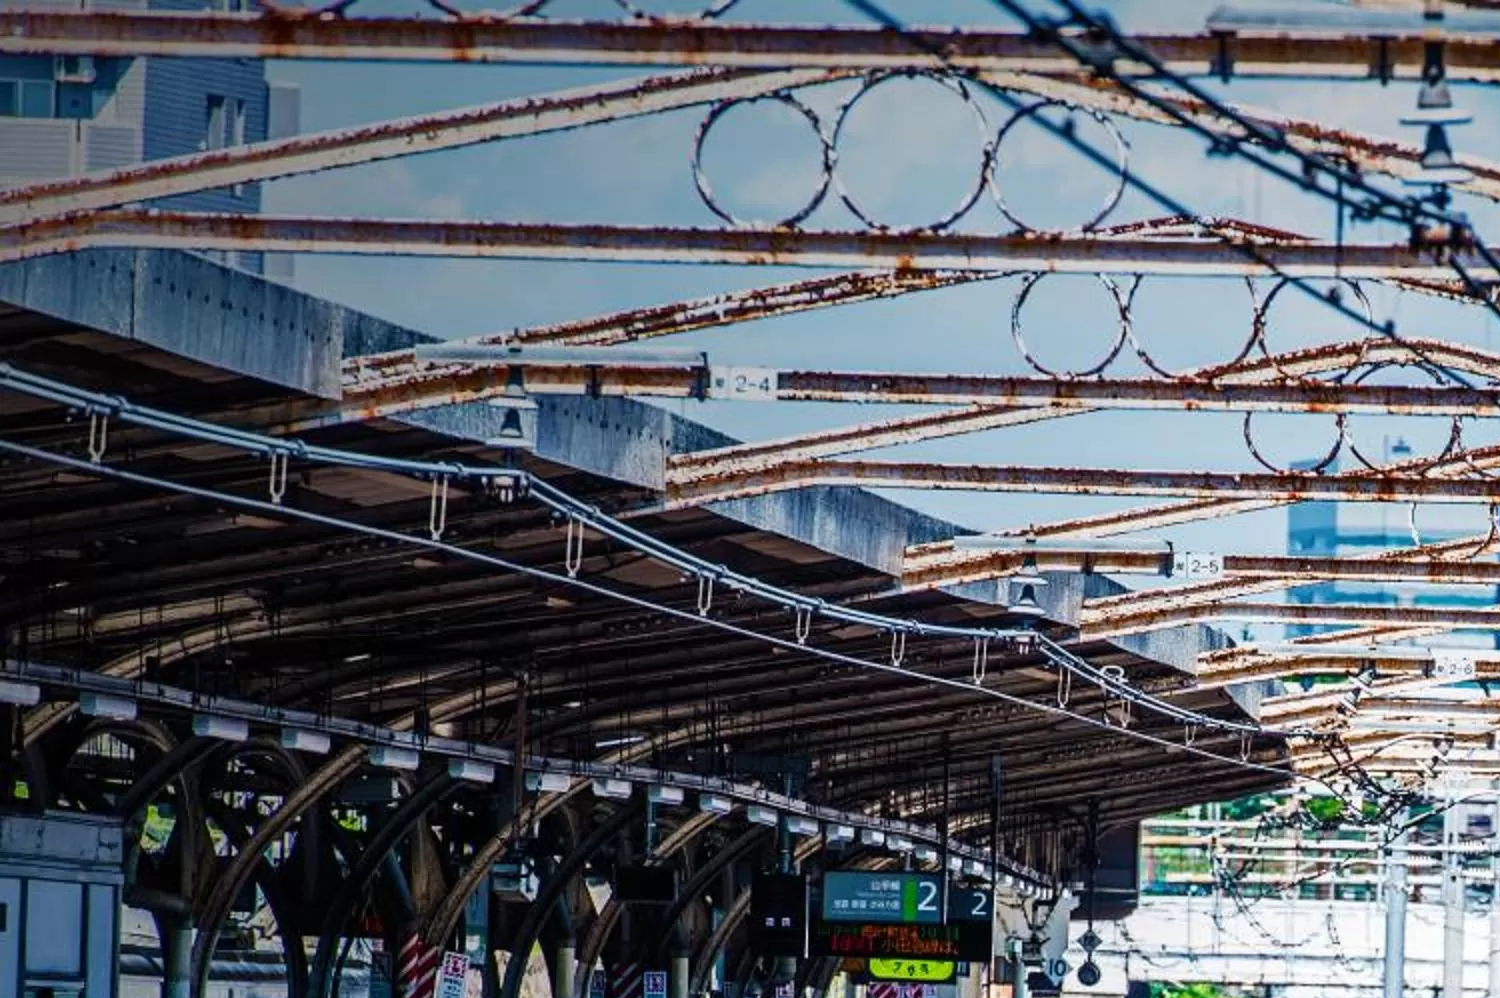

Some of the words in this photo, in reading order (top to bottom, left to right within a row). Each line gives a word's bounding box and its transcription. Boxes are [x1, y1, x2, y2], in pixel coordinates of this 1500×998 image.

[735, 375, 769, 393] 2-4
[1192, 560, 1219, 574] 2-5
[917, 881, 937, 912] 2
[971, 892, 988, 916] 2
[1049, 958, 1067, 977] 10
